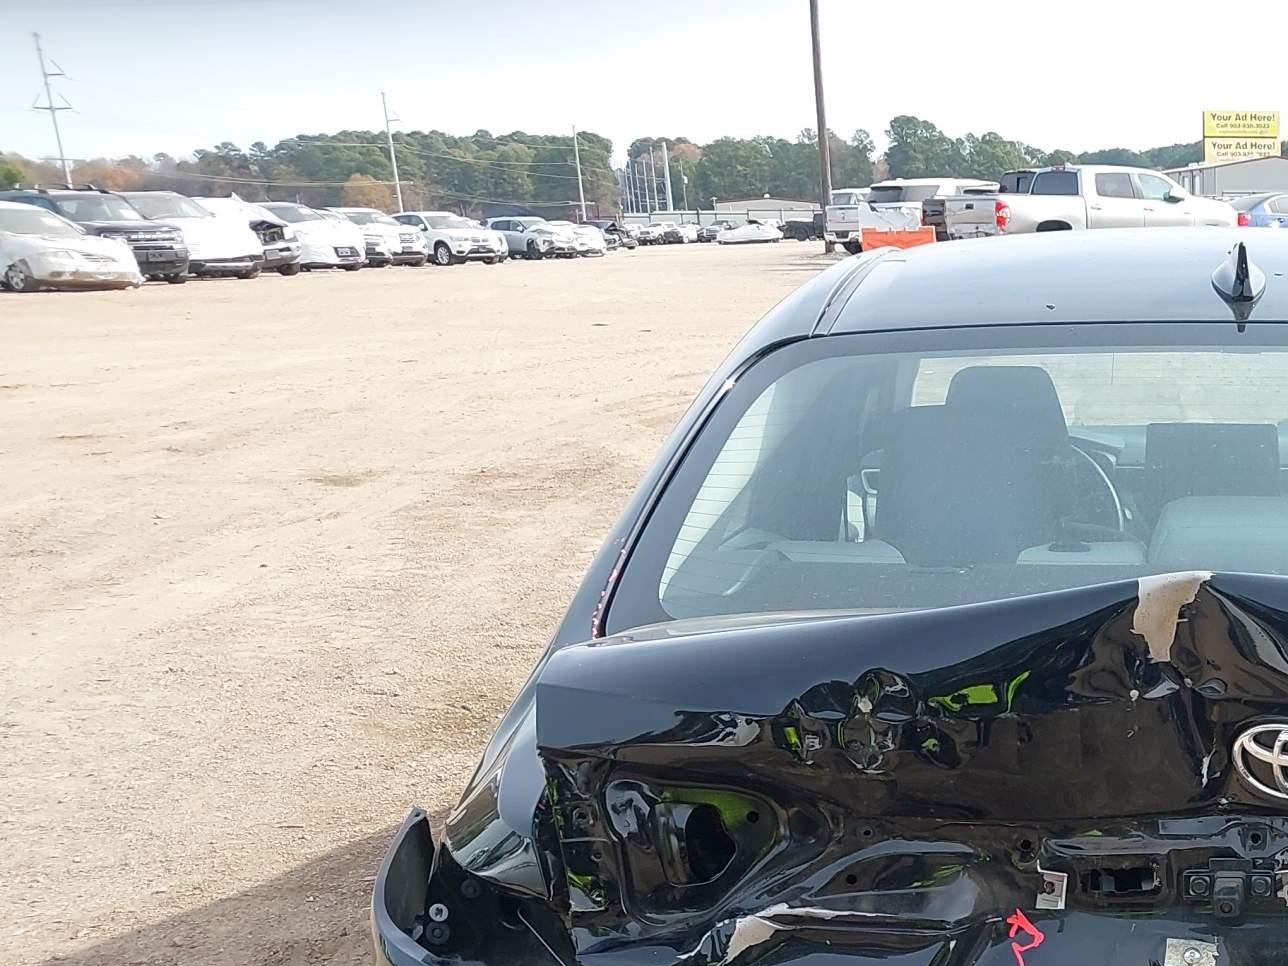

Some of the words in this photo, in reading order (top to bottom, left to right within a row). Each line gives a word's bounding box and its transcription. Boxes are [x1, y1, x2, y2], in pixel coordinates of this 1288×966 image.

[1211, 113, 1232, 121] Your
[1235, 113, 1247, 121] Ad
[1250, 113, 1275, 121] Here!
[1212, 142, 1232, 150] Your
[1235, 142, 1247, 150] Ad
[1250, 142, 1275, 150] Here!
